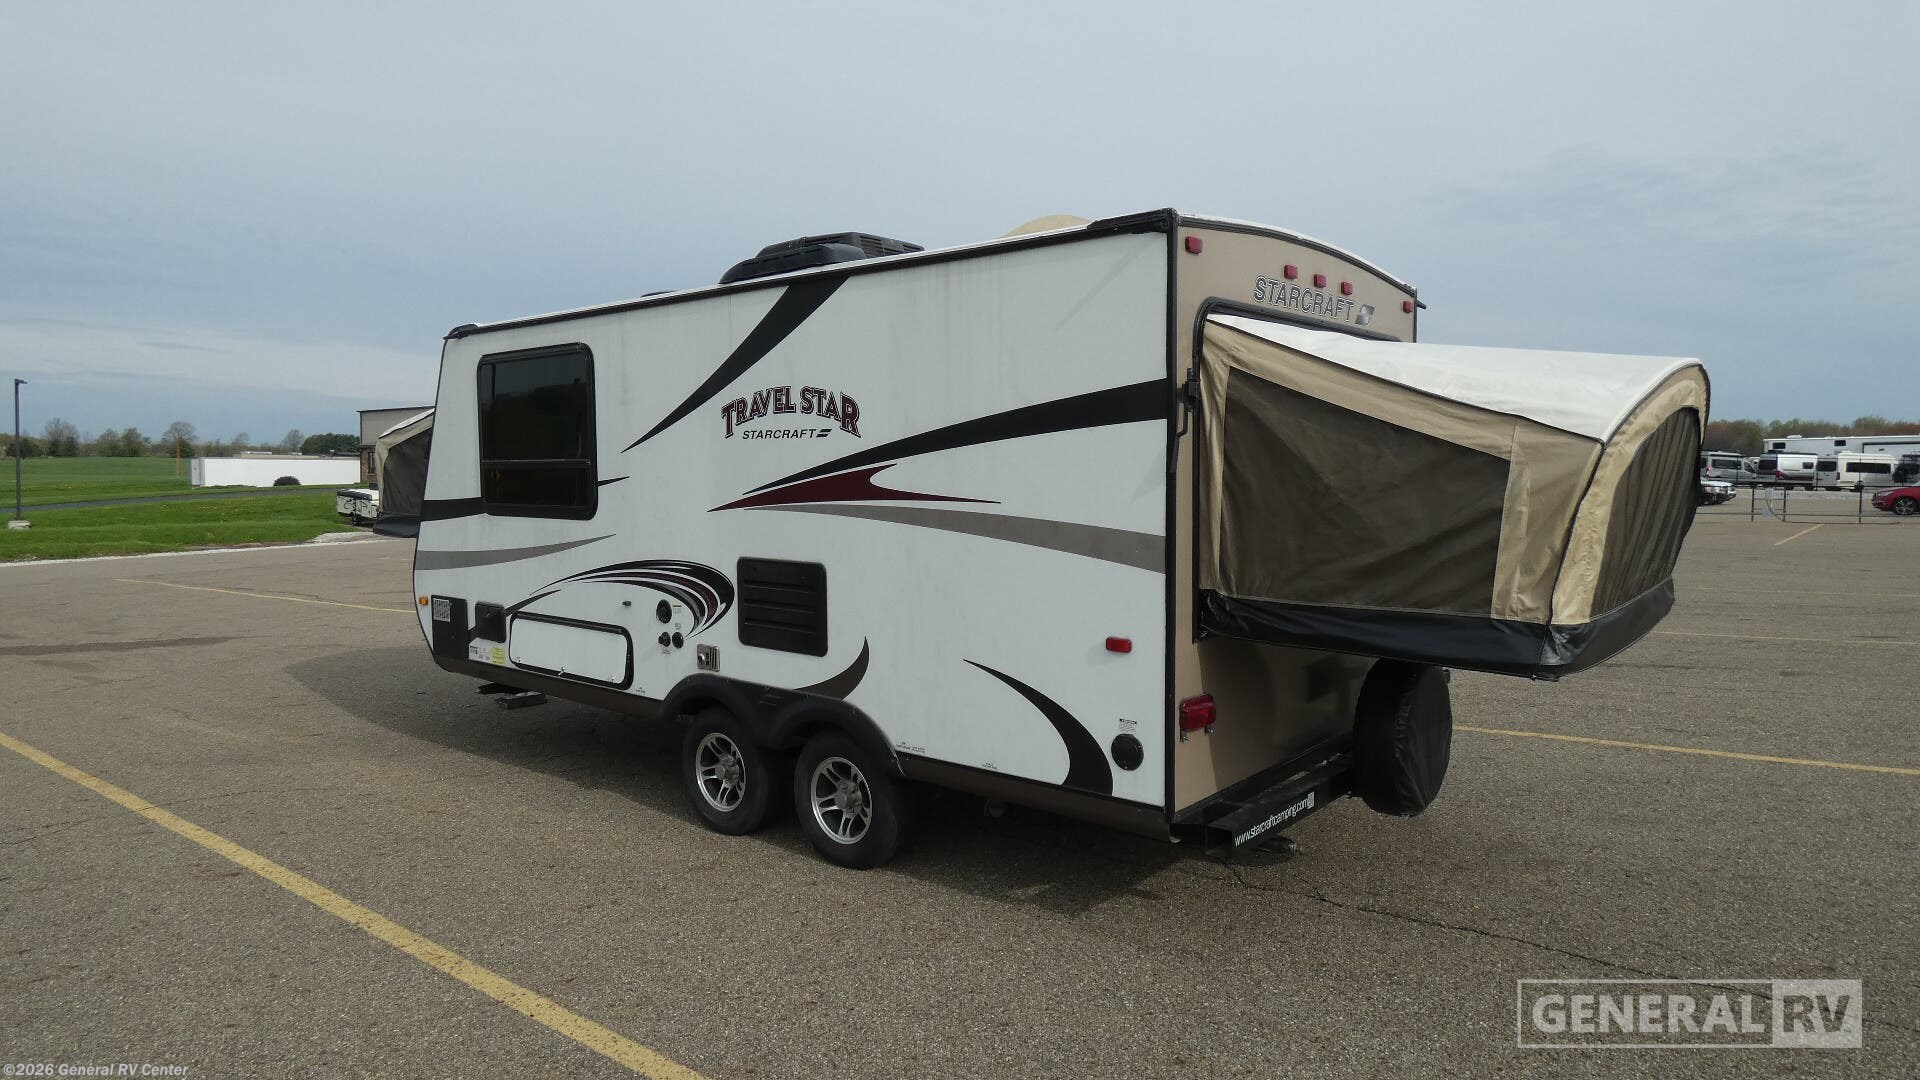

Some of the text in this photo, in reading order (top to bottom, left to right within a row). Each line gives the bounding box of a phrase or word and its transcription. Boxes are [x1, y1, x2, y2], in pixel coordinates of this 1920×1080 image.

[1254, 274, 1355, 322] STARCRAFT
[721, 385, 862, 439] TRAVEL STAR
[742, 428, 817, 440] STARCRAFT
[1234, 798, 1308, 848] www.starcraftcamping.com
